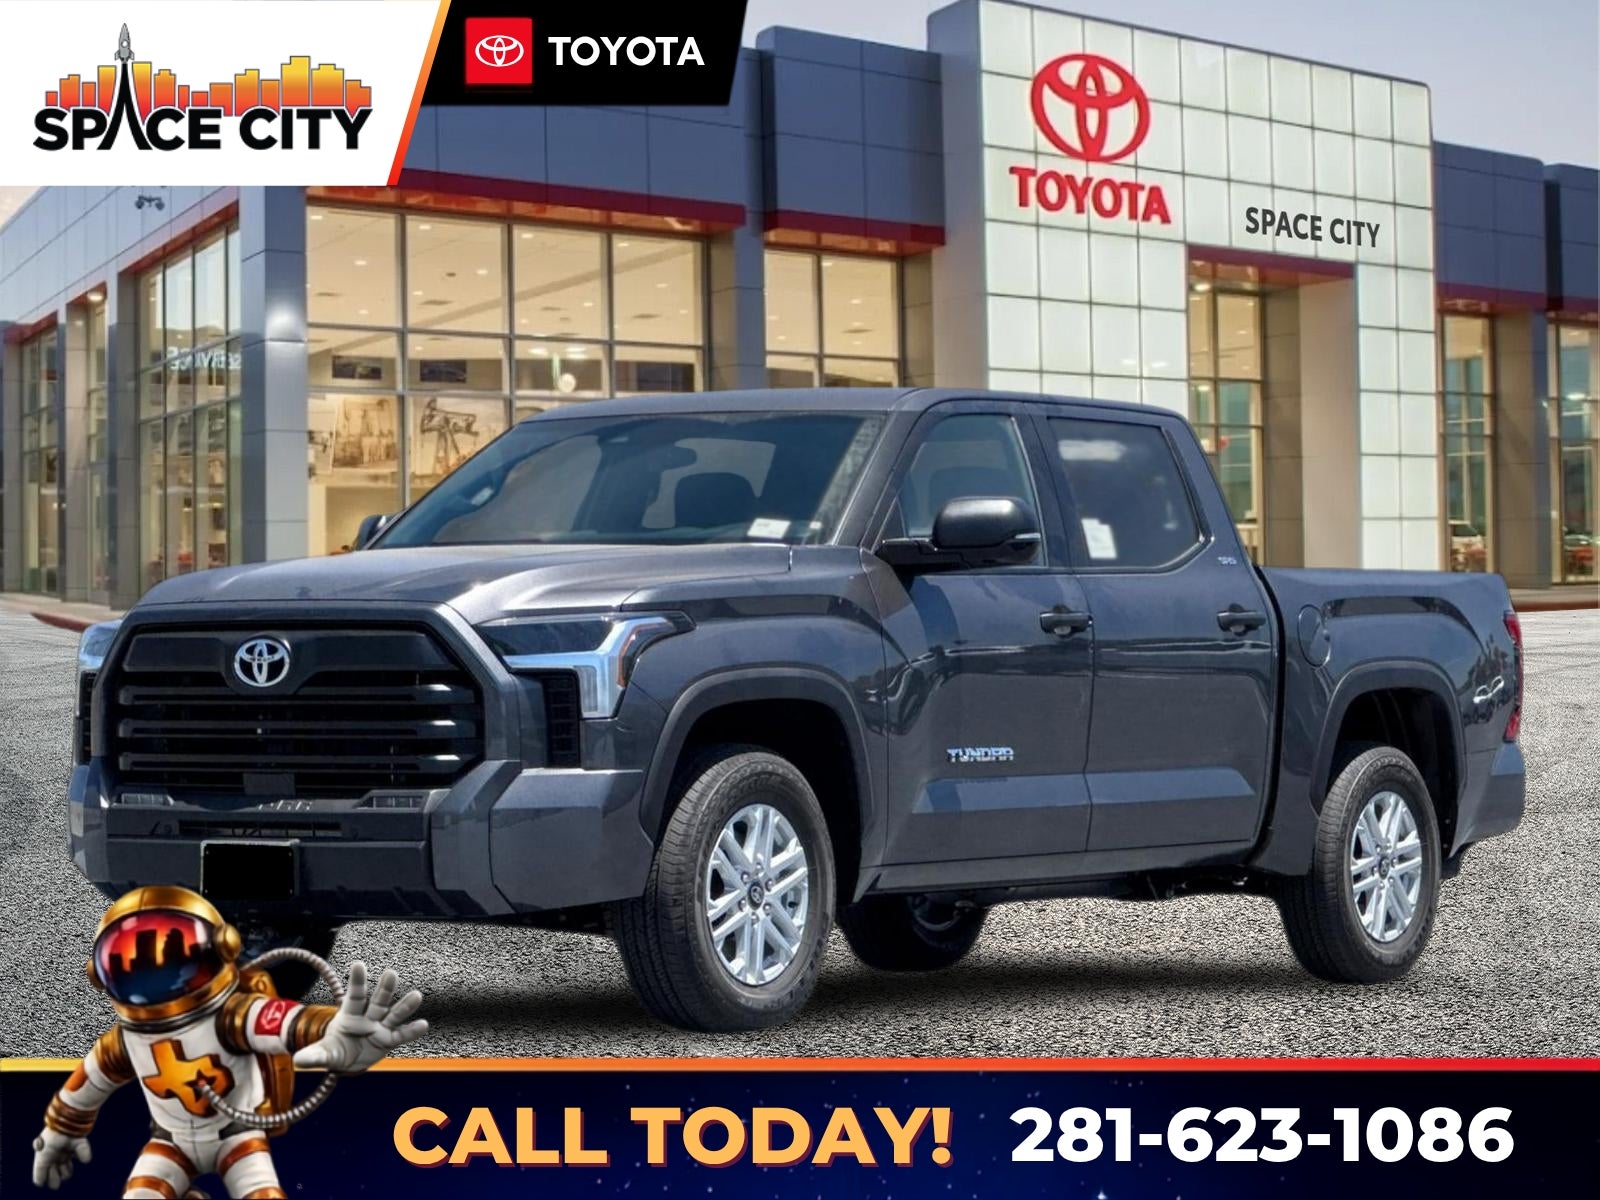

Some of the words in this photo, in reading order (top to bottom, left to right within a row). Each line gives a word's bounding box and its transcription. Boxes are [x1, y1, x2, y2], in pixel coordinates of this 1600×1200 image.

[1009, 166, 1172, 225] TOYOTA
[1245, 206, 1323, 242] SPACE
[1329, 217, 1381, 248] CITY
[946, 746, 1014, 763] TUNDRA
